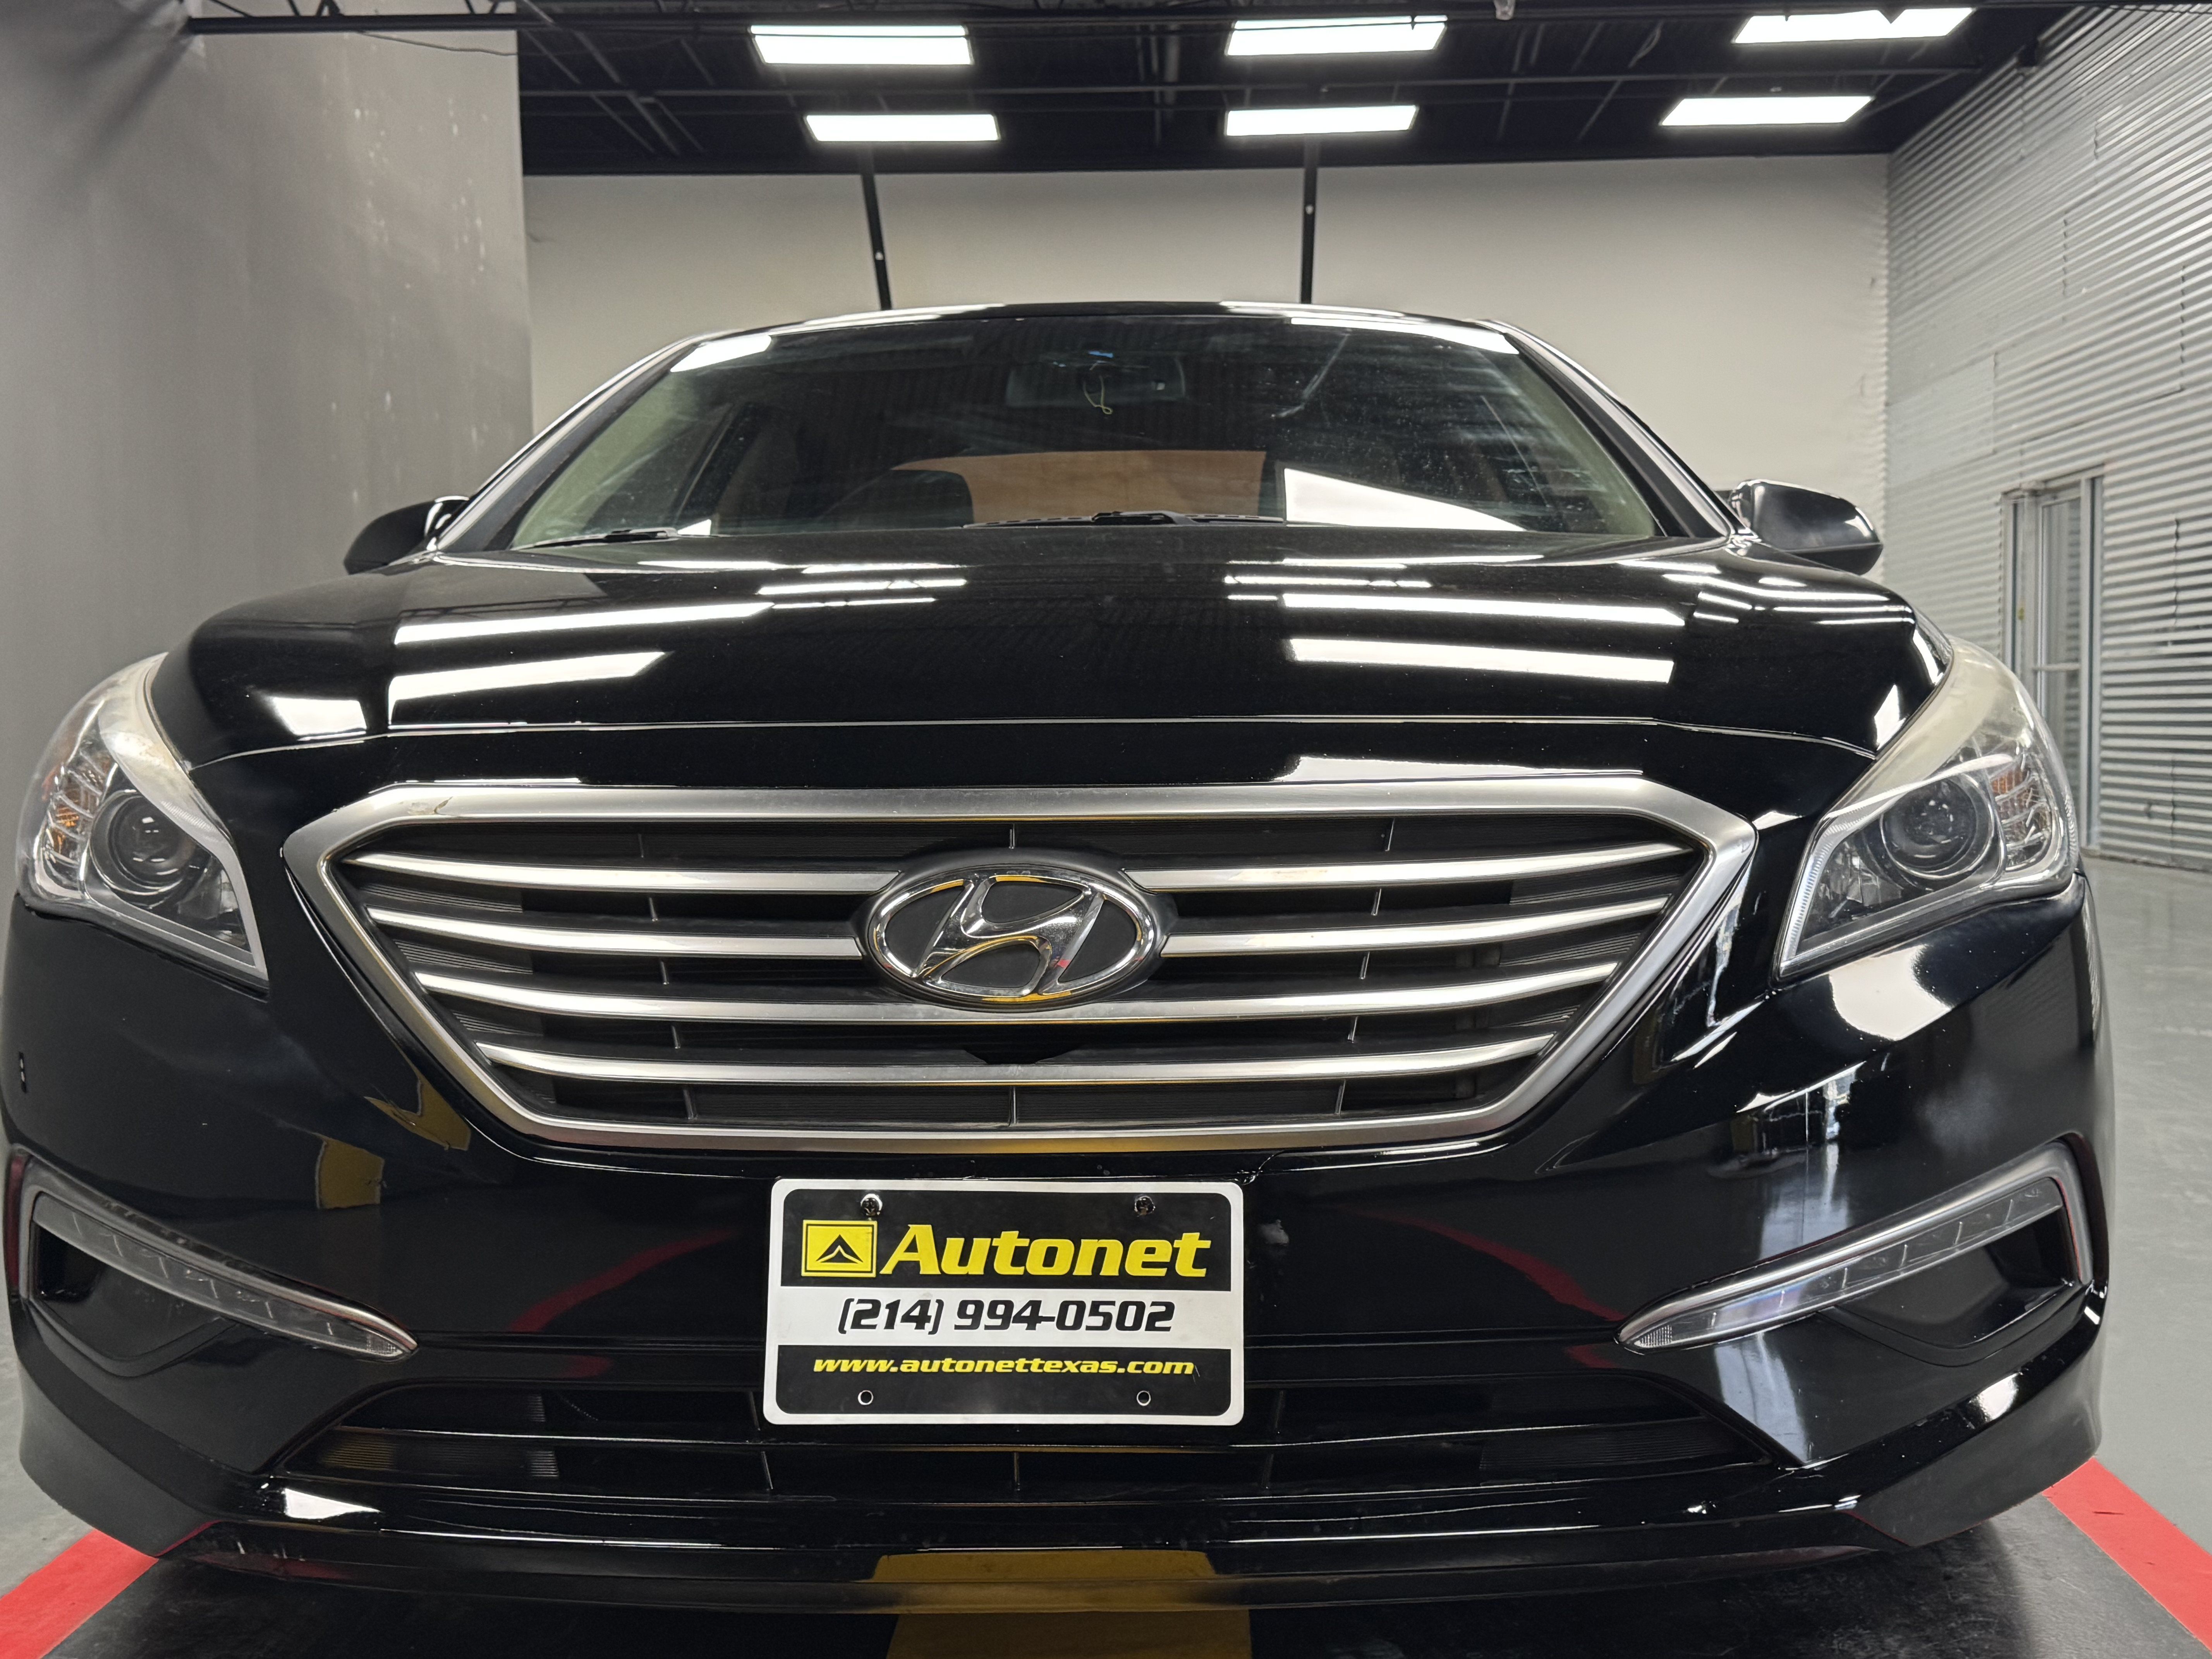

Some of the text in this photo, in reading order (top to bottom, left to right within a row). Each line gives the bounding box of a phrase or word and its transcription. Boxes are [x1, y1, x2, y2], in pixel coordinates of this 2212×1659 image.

[879, 1224, 1212, 1278] Autonet
[838, 1298, 1175, 1335] (214) 994-0502
[813, 1357, 1195, 1375] www.autonettexas.com
